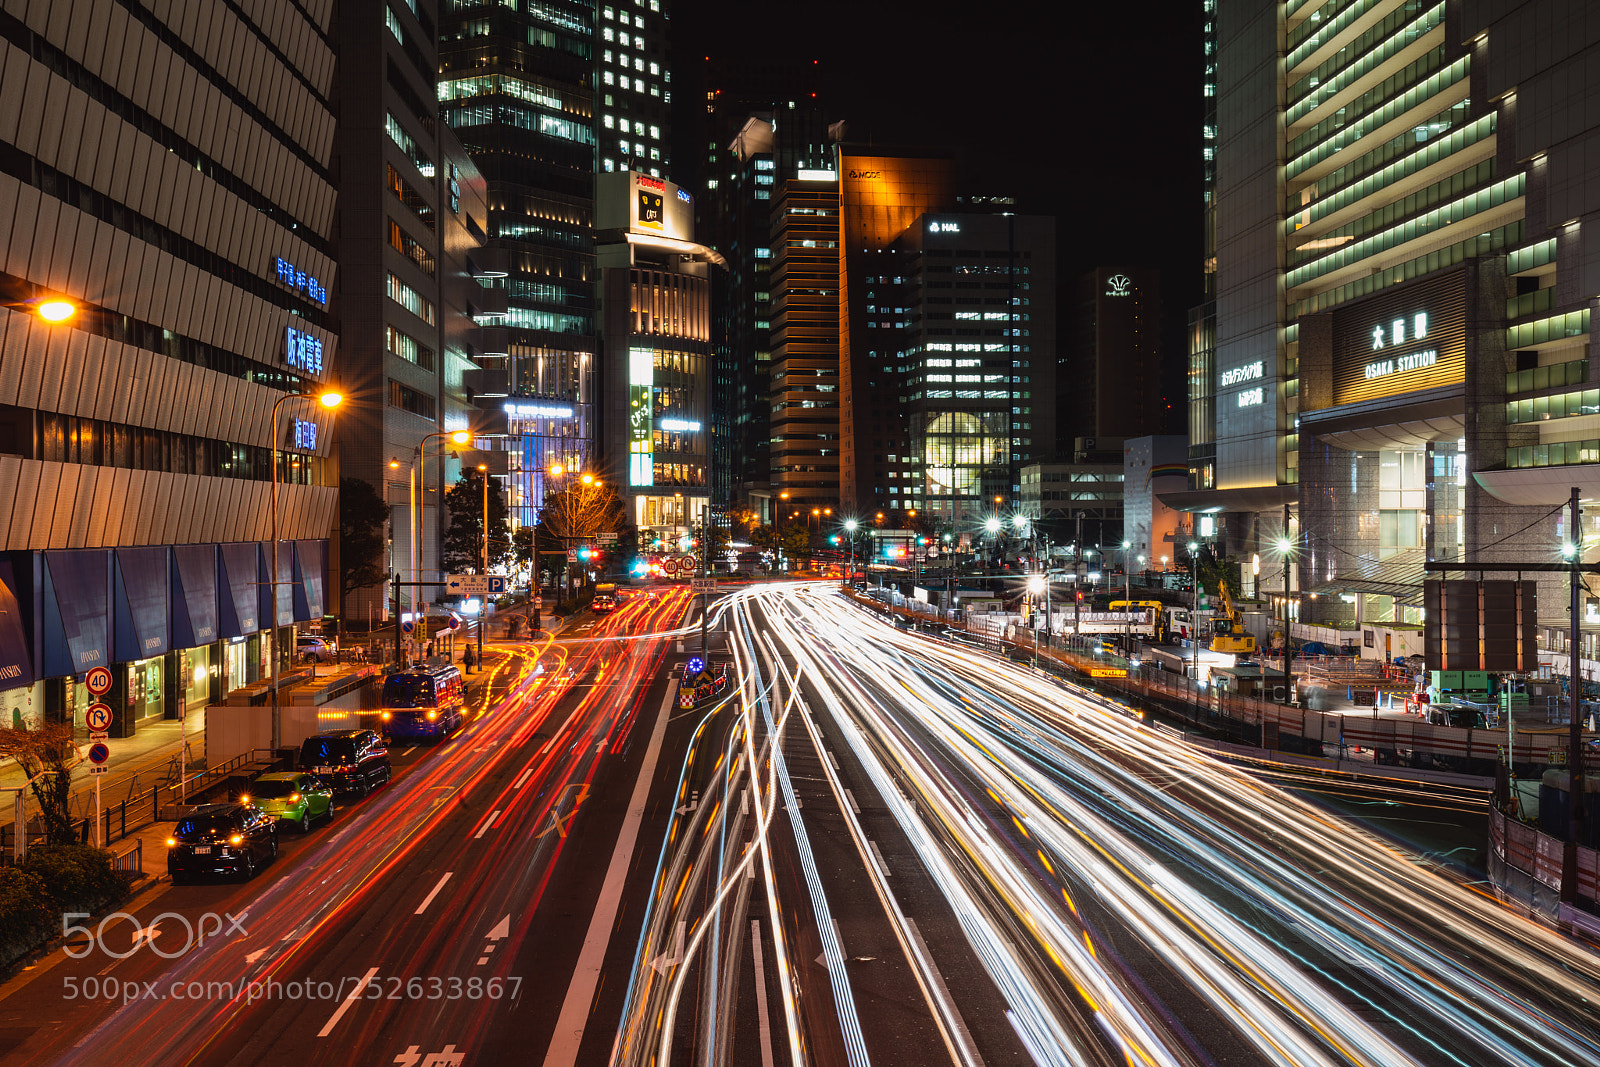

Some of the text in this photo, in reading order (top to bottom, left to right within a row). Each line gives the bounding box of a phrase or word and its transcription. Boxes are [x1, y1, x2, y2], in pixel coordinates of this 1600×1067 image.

[941, 223, 960, 233] HAL
[1365, 350, 1436, 379] OSAKA STATION
[667, 563, 676, 571] 40
[492, 578, 501, 591] P
[80, 649, 101, 663] HANSHIN
[91, 674, 106, 687] 40
